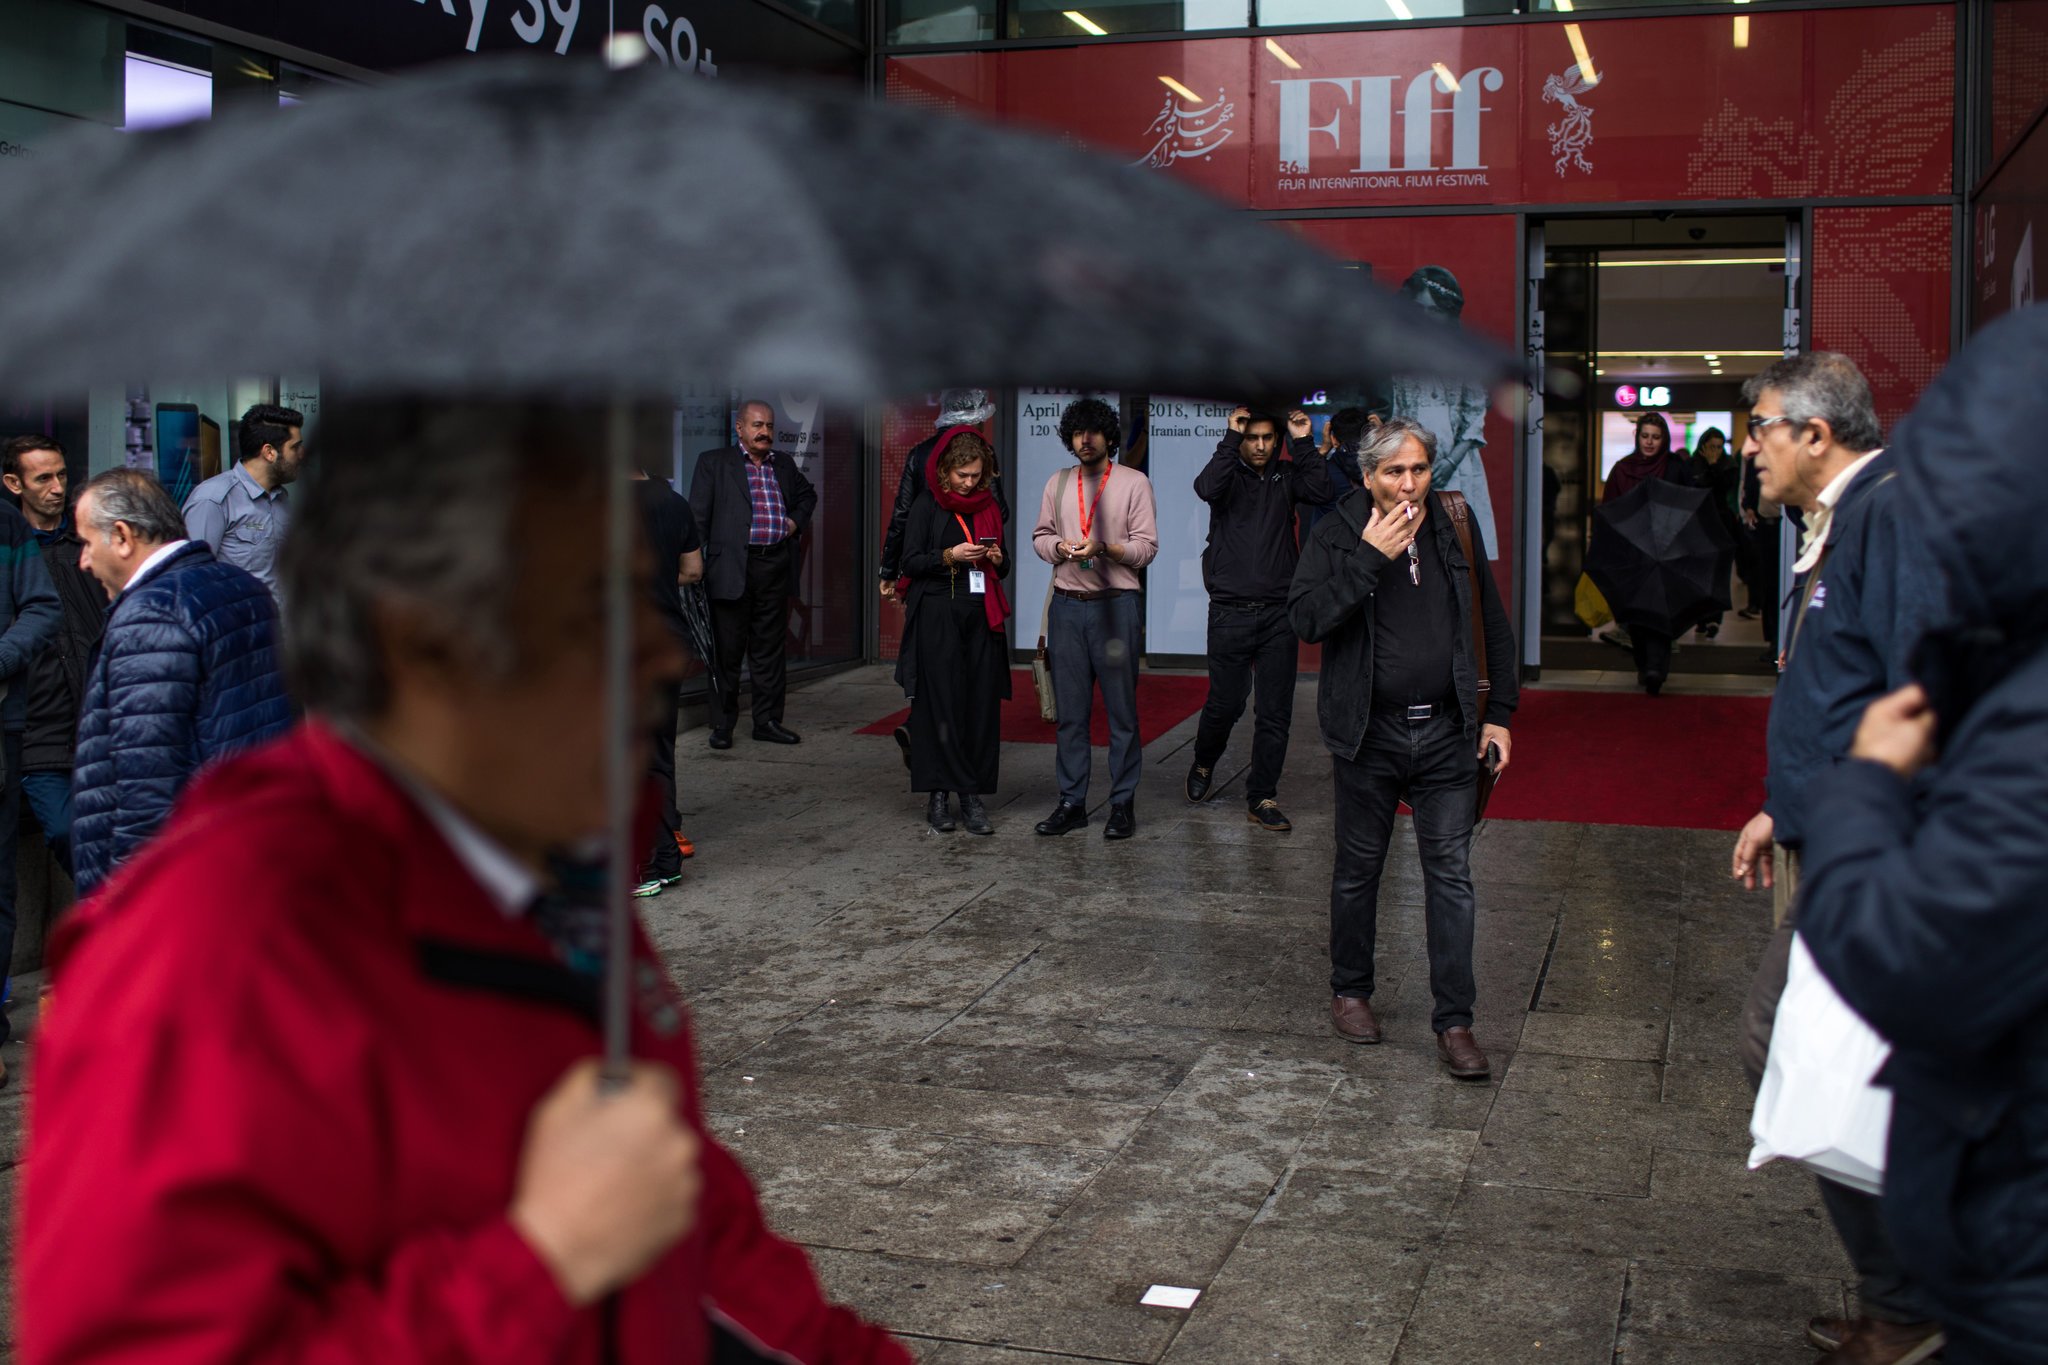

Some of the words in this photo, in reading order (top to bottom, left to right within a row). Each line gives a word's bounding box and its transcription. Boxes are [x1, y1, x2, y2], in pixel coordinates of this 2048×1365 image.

[1278, 177, 1306, 191] FAJR
[1309, 175, 1402, 190] INTERNATIONAL
[1405, 174, 1433, 188] FILM
[1435, 173, 1490, 187] FESTIVAL
[1302, 390, 1327, 406] LG
[1639, 386, 1671, 406] LG
[1023, 402, 1060, 420] April
[1148, 402, 1189, 419] 2018,
[1193, 403, 1236, 418] Tehra
[1030, 424, 1050, 436] 120
[1151, 424, 1191, 437] Iranian
[1194, 424, 1230, 437] Cine
